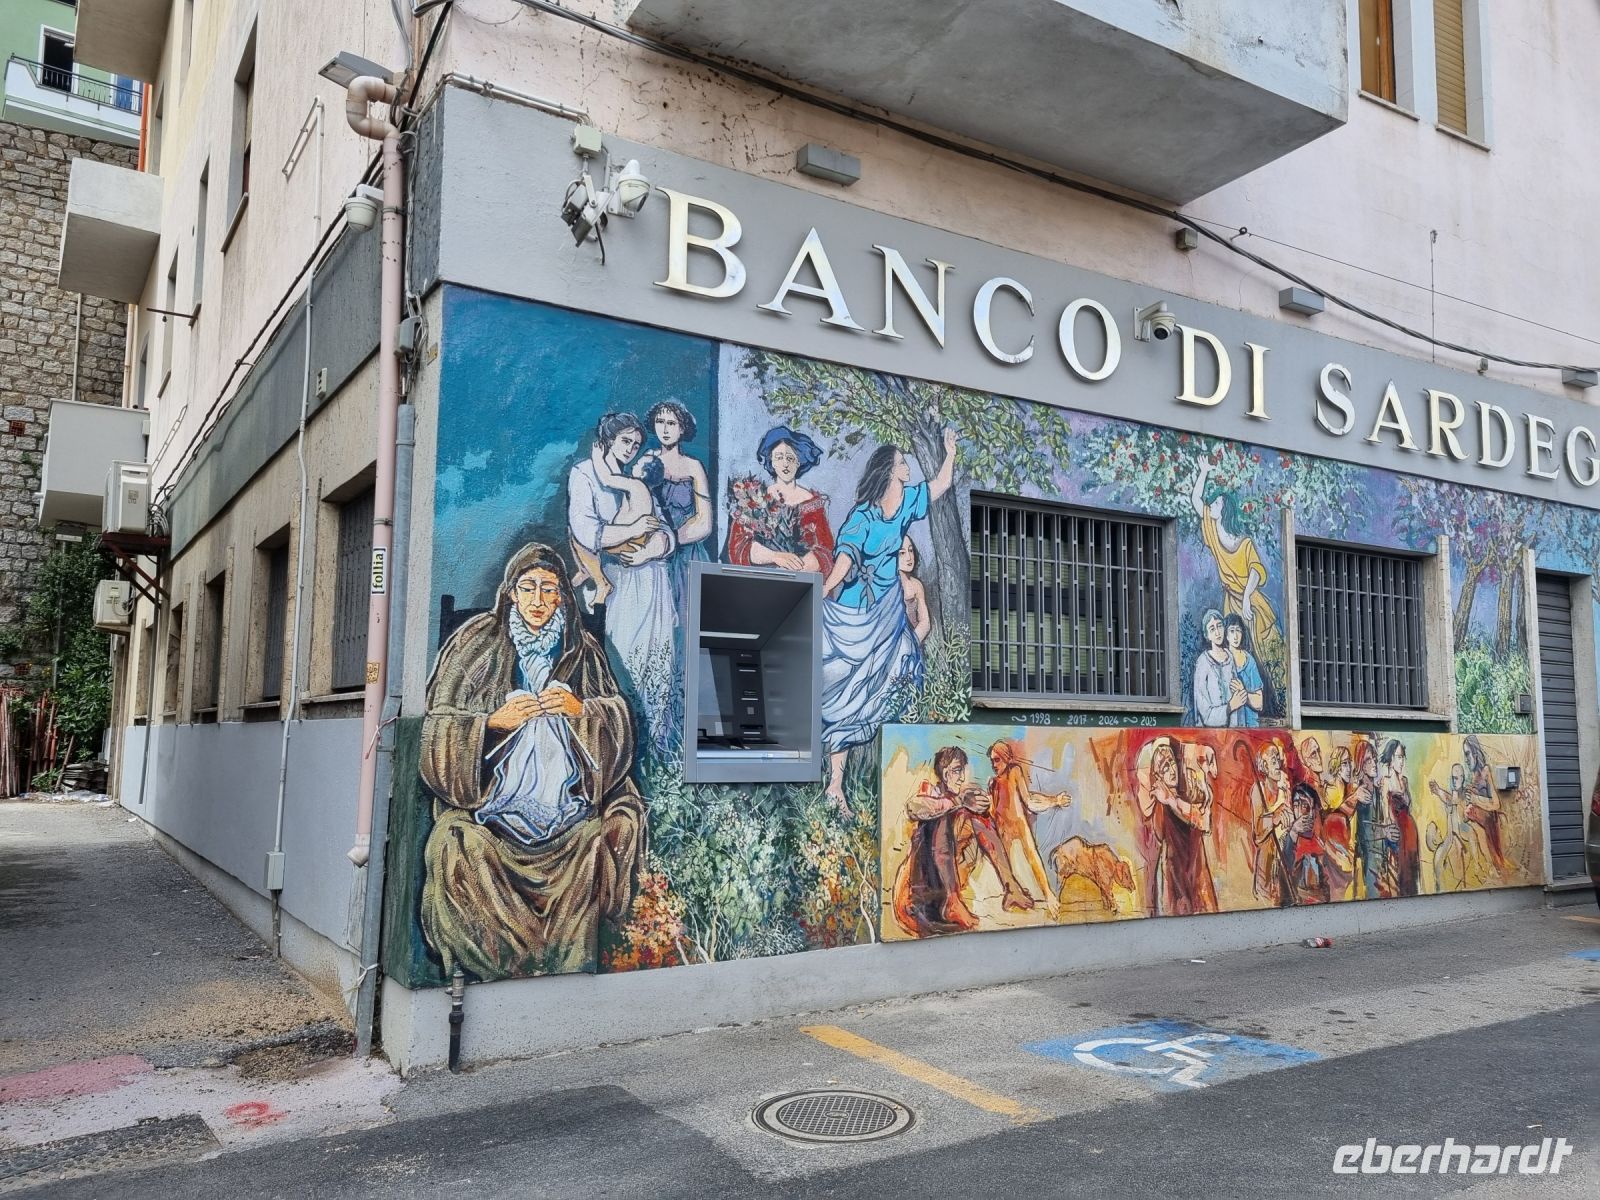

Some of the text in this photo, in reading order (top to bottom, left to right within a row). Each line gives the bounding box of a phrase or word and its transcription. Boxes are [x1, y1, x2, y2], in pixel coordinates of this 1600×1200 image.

[653, 185, 1600, 487] BANCO DI SARDEG
[1030, 713, 1157, 727] 1998 2017 2024 2025
